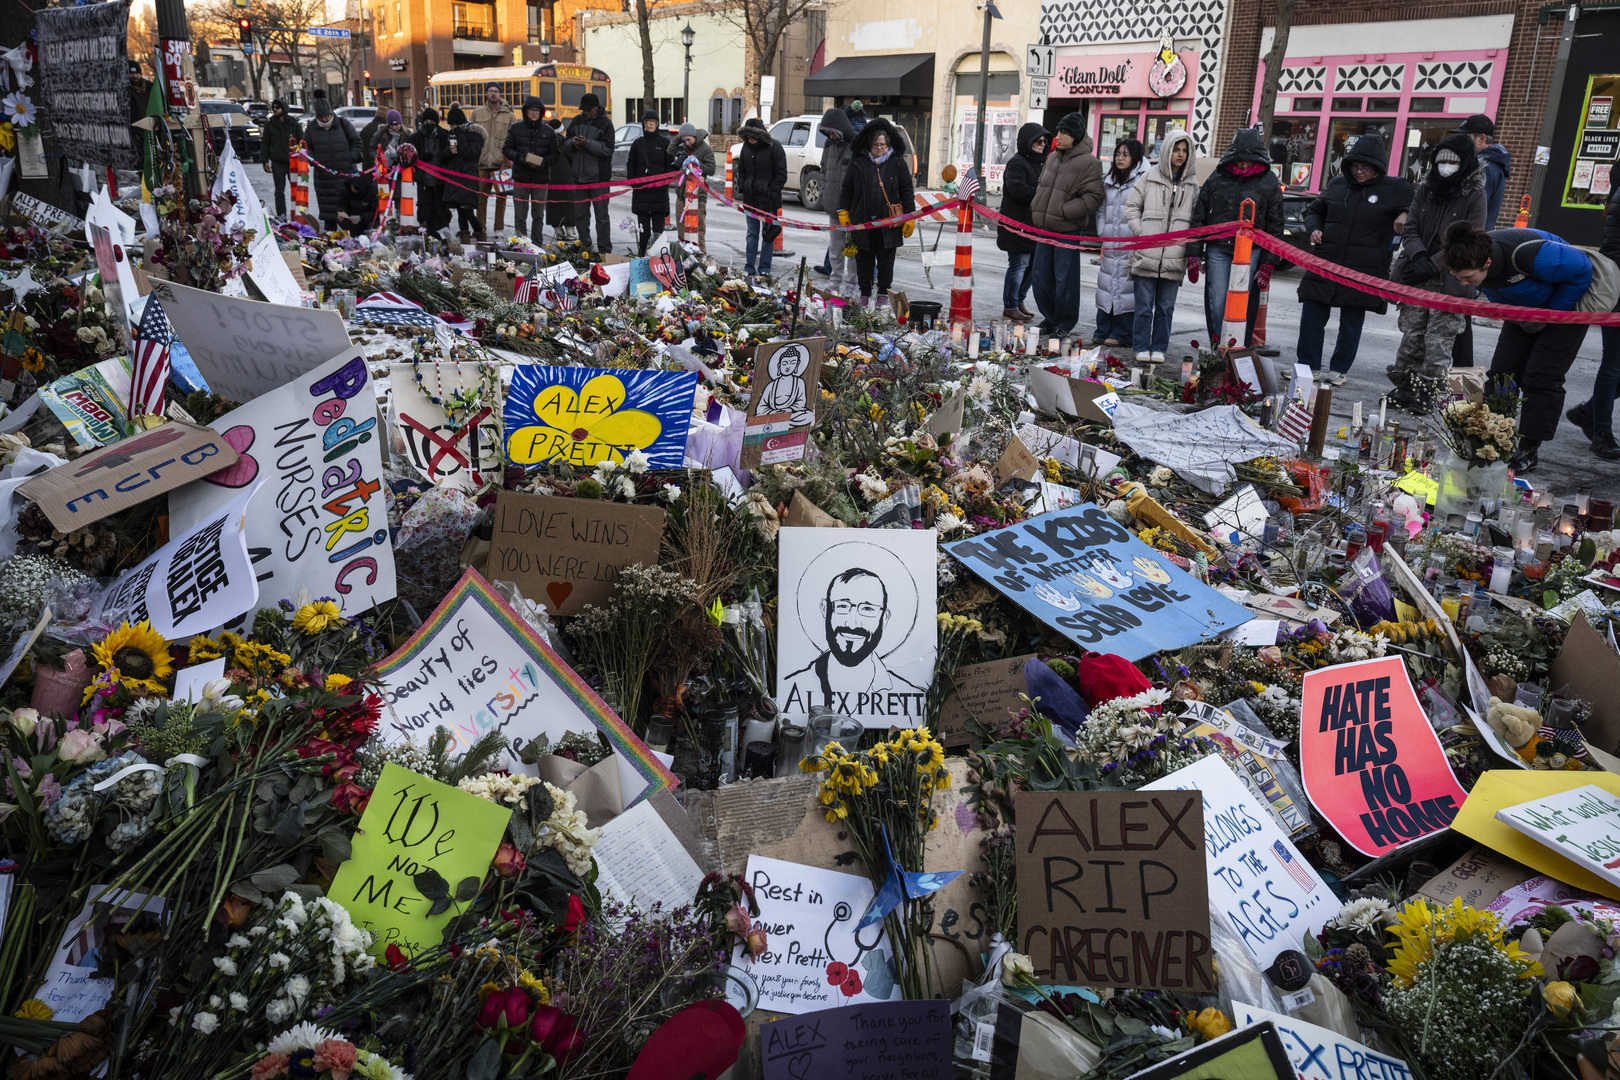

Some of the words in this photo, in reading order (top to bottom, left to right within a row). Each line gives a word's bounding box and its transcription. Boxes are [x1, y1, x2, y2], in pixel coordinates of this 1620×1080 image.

[557, 67, 576, 76] SCHOOL
[577, 68, 590, 77] BUS
[1065, 66, 1097, 84] Glam
[1099, 65, 1126, 84] Doll
[1069, 85, 1120, 94] DONUTS
[1591, 106, 1609, 114] FREE
[15, 194, 40, 210] ALEX
[654, 263, 672, 273] LOVE
[542, 392, 620, 415] ALEX
[400, 423, 500, 477] ICE
[528, 432, 636, 461] PRETTI
[65, 442, 220, 513] BLUE
[274, 417, 321, 562] NURSES
[309, 356, 387, 594] Pediatric
[501, 504, 568, 538] LOVE
[571, 517, 629, 547] WINS.
[950, 529, 1048, 571] THE
[1023, 508, 1130, 559] KIDS
[168, 529, 203, 573] FOR
[194, 512, 231, 604] JUSTICE
[499, 547, 531, 572] YOU
[536, 554, 588, 580] WERE
[166, 559, 202, 628] ALEX
[993, 569, 1032, 592] OF
[1055, 604, 1143, 643] SEND
[1119, 581, 1192, 612] LOVE
[374, 647, 453, 706] beauty
[451, 618, 474, 650] of
[457, 655, 498, 695] lies
[954, 669, 971, 679] Alex
[782, 682, 850, 716] ALEX
[1319, 676, 1391, 734] HATE
[1186, 702, 1230, 733] ALEX
[1235, 725, 1282, 760] PRETTI
[1335, 721, 1398, 776] HAS
[1238, 749, 1287, 804] REST
[1279, 803, 1310, 833] IN
[1359, 763, 1412, 811] NO
[382, 784, 455, 861] We
[1027, 797, 1197, 854] ALEX
[1359, 794, 1460, 848] HOME
[1511, 804, 1577, 831] What
[1568, 791, 1619, 820] would
[753, 870, 803, 902] Rest
[808, 889, 823, 904] in
[1043, 856, 1178, 920] RIP
[1213, 866, 1244, 894] TO
[1237, 848, 1268, 877] THE
[1434, 879, 1457, 896] the
[352, 875, 422, 914] ME
[748, 917, 795, 936] ower
[787, 940, 828, 968] Pretti
[1024, 924, 1213, 990] CAREGIVER
[46, 988, 67, 1001] for
[58, 971, 90, 985] Thank
[759, 986, 769, 995] the
[770, 989, 790, 1001] justice
[790, 992, 803, 1003] you
[802, 993, 828, 1001] deserve
[761, 974, 776, 986] you
[800, 976, 821, 993] family
[767, 1019, 826, 1053] ALEX
[850, 1013, 896, 1032] Thank
[898, 1016, 921, 1033] you
[843, 1037, 888, 1053] taking
[893, 1037, 919, 1046] care
[926, 1032, 941, 1044] of
[846, 1056, 868, 1074] your
[878, 1052, 943, 1066] neighbors,
[922, 1068, 939, 1078] all
